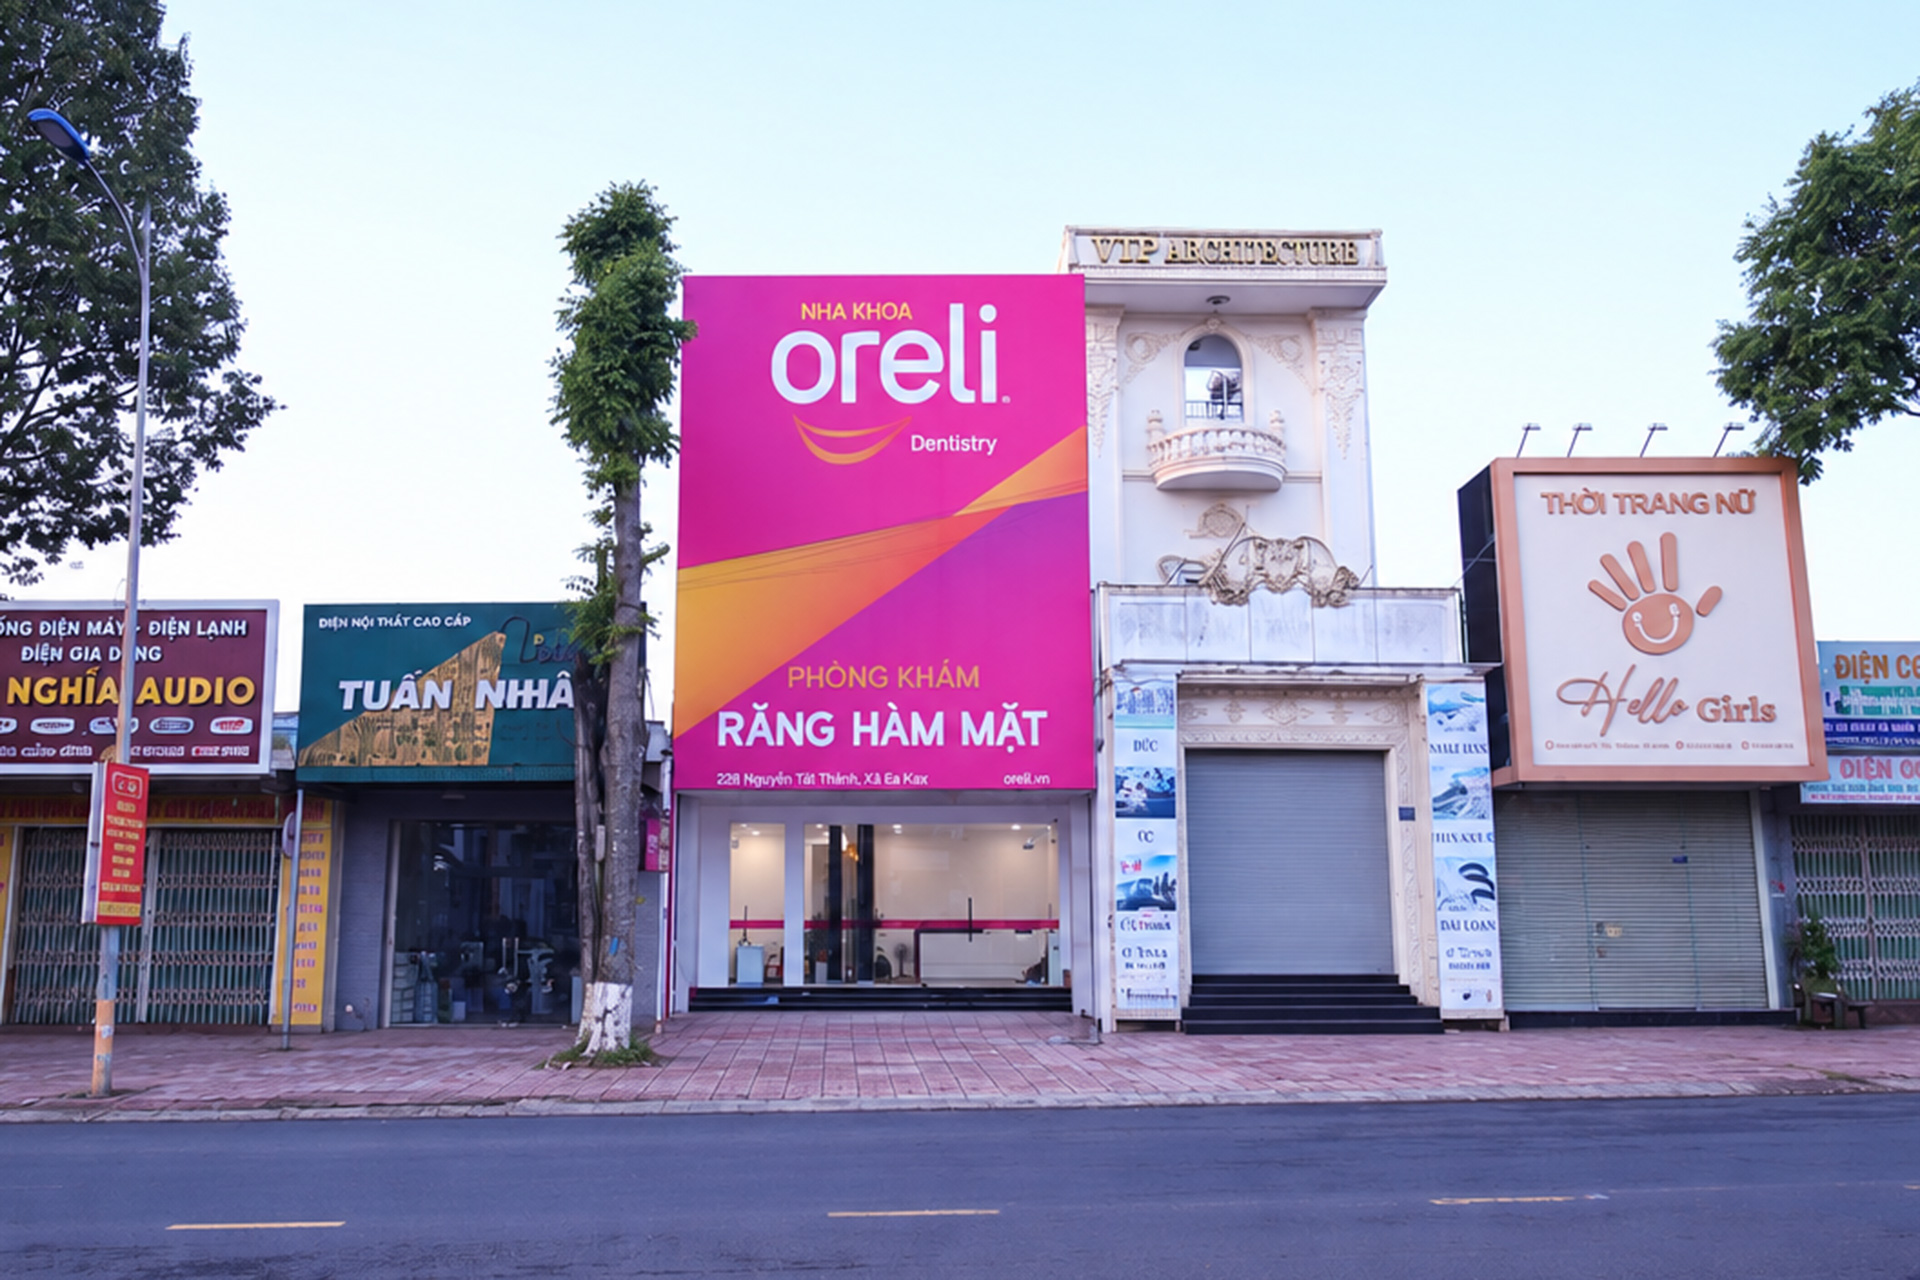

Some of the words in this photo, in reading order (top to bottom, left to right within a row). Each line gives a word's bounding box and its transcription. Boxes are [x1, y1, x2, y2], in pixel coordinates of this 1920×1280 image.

[1092, 236, 1158, 264] VIP
[1164, 238, 1360, 266] ARCHITECTURE
[801, 302, 847, 320] NHA
[852, 302, 913, 320] KHOA
[771, 303, 998, 404] oreli
[911, 434, 998, 456] Dentistry
[1541, 488, 1607, 515] THỜI
[1614, 492, 1709, 515] TRANG
[1716, 489, 1757, 515] NỮ
[196, 619, 248, 642] LẠNH
[413, 616, 441, 628] CAO
[69, 645, 102, 663] GIA
[109, 645, 163, 663] DNG
[788, 661, 889, 689] PHÒNG
[898, 659, 980, 689] KHÁM
[136, 676, 256, 706] AUDIO
[339, 670, 453, 710] TUẤN
[1556, 664, 1689, 737] Hello
[1696, 694, 1777, 723] Girls
[718, 702, 835, 747] RĂNG
[853, 702, 945, 747] HÀM
[961, 702, 1048, 753] MẶT
